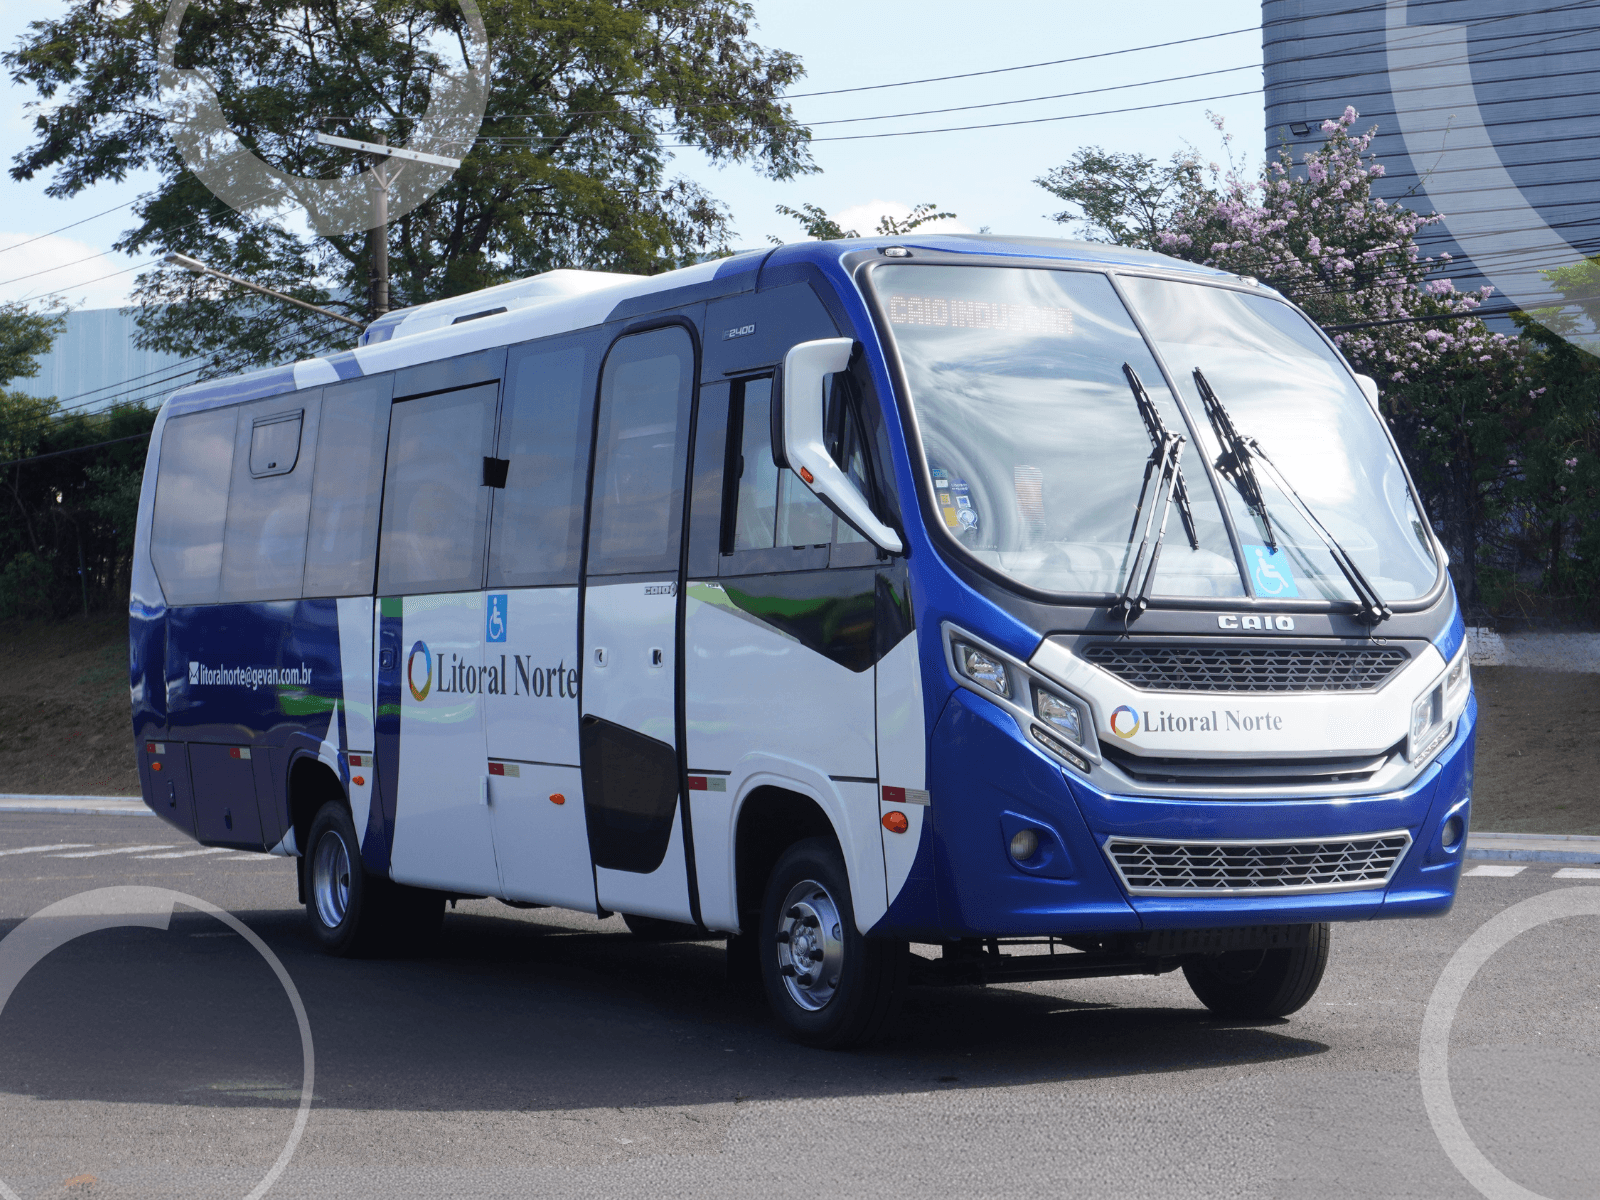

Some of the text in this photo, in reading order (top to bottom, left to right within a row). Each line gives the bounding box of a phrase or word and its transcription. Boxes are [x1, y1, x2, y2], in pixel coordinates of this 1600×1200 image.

[890, 296, 948, 326] CAIO
[1217, 615, 1295, 631] CAIO
[200, 661, 312, 690] litoralnorte@gevan.com.br
[436, 653, 579, 699] Litoral Norte
[1143, 709, 1283, 733] Litoral Norte
